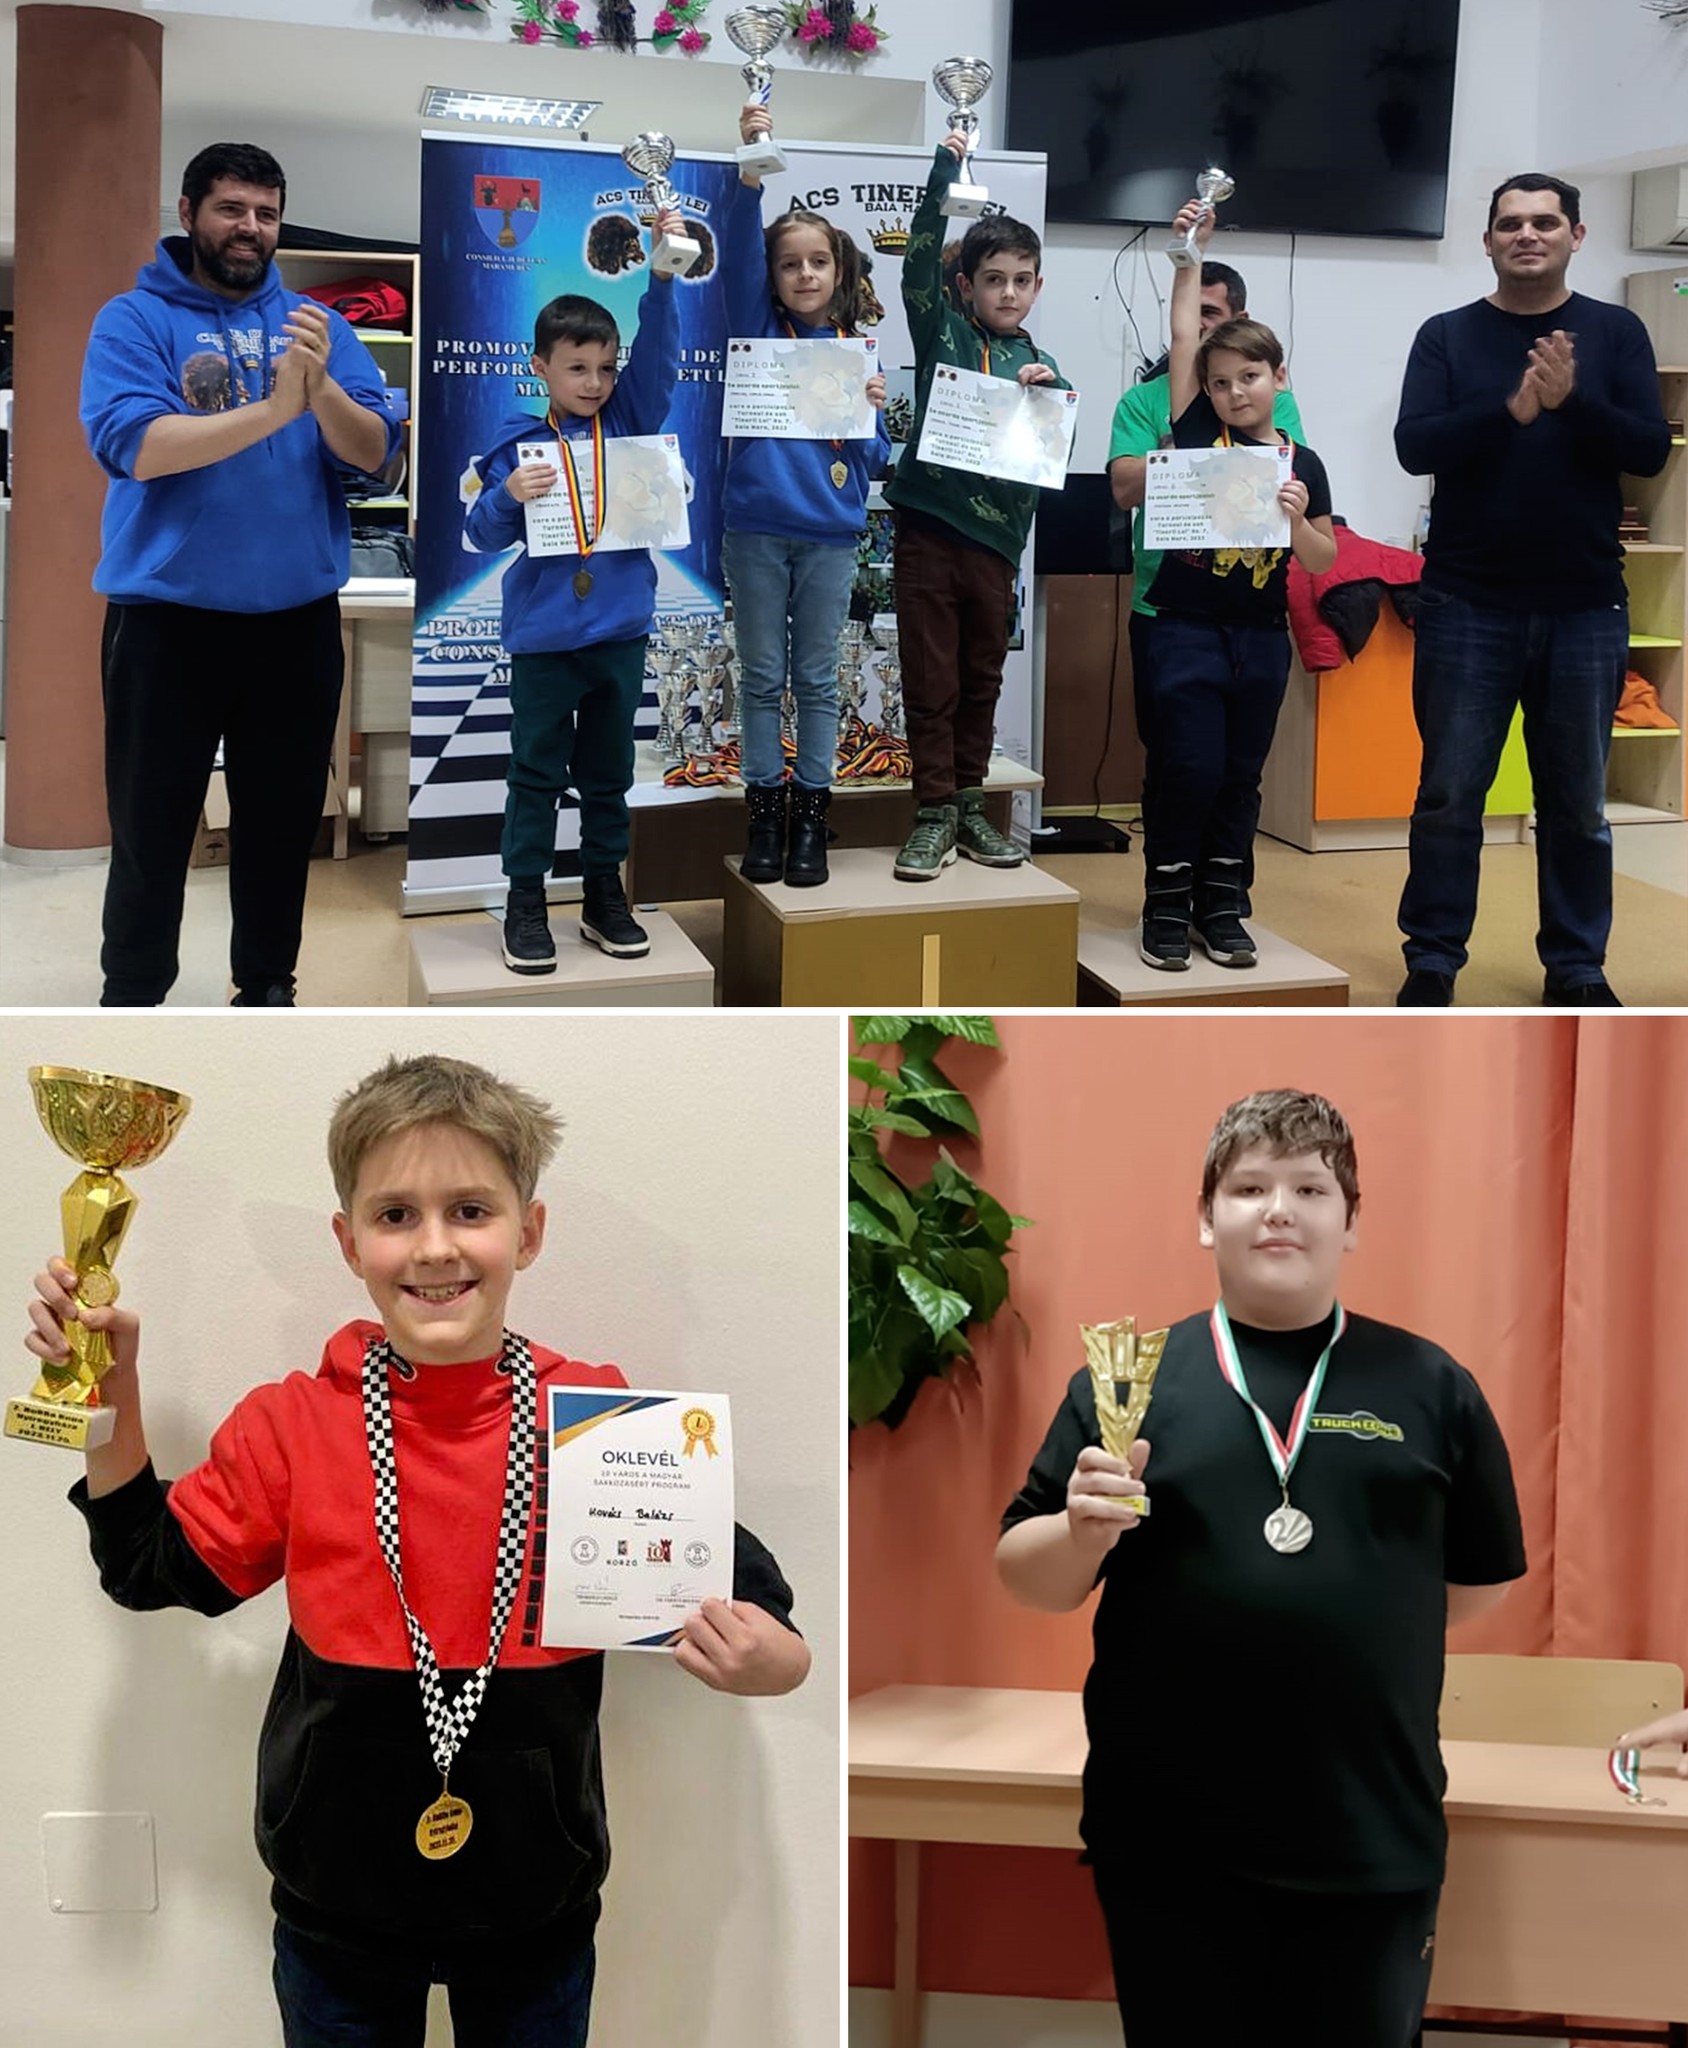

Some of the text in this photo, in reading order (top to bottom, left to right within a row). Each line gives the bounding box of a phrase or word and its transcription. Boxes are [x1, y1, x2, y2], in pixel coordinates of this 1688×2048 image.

[596, 191, 623, 205] ACS
[685, 196, 708, 212] LEI
[789, 187, 839, 213] ACS
[851, 184, 927, 204] TINER
[865, 203, 922, 213] BAIA MA
[436, 339, 533, 356] PROMOV
[694, 349, 720, 363] DE
[432, 359, 535, 376] PERFOR
[733, 361, 785, 369] DIPLOMA
[937, 387, 987, 404] DIPLOMA
[1152, 471, 1200, 480] DIPLOMA
[427, 619, 501, 637] PROI
[602, 1450, 679, 1467] OKLEVÉL
[649, 1472, 683, 1480] MAGYAR
